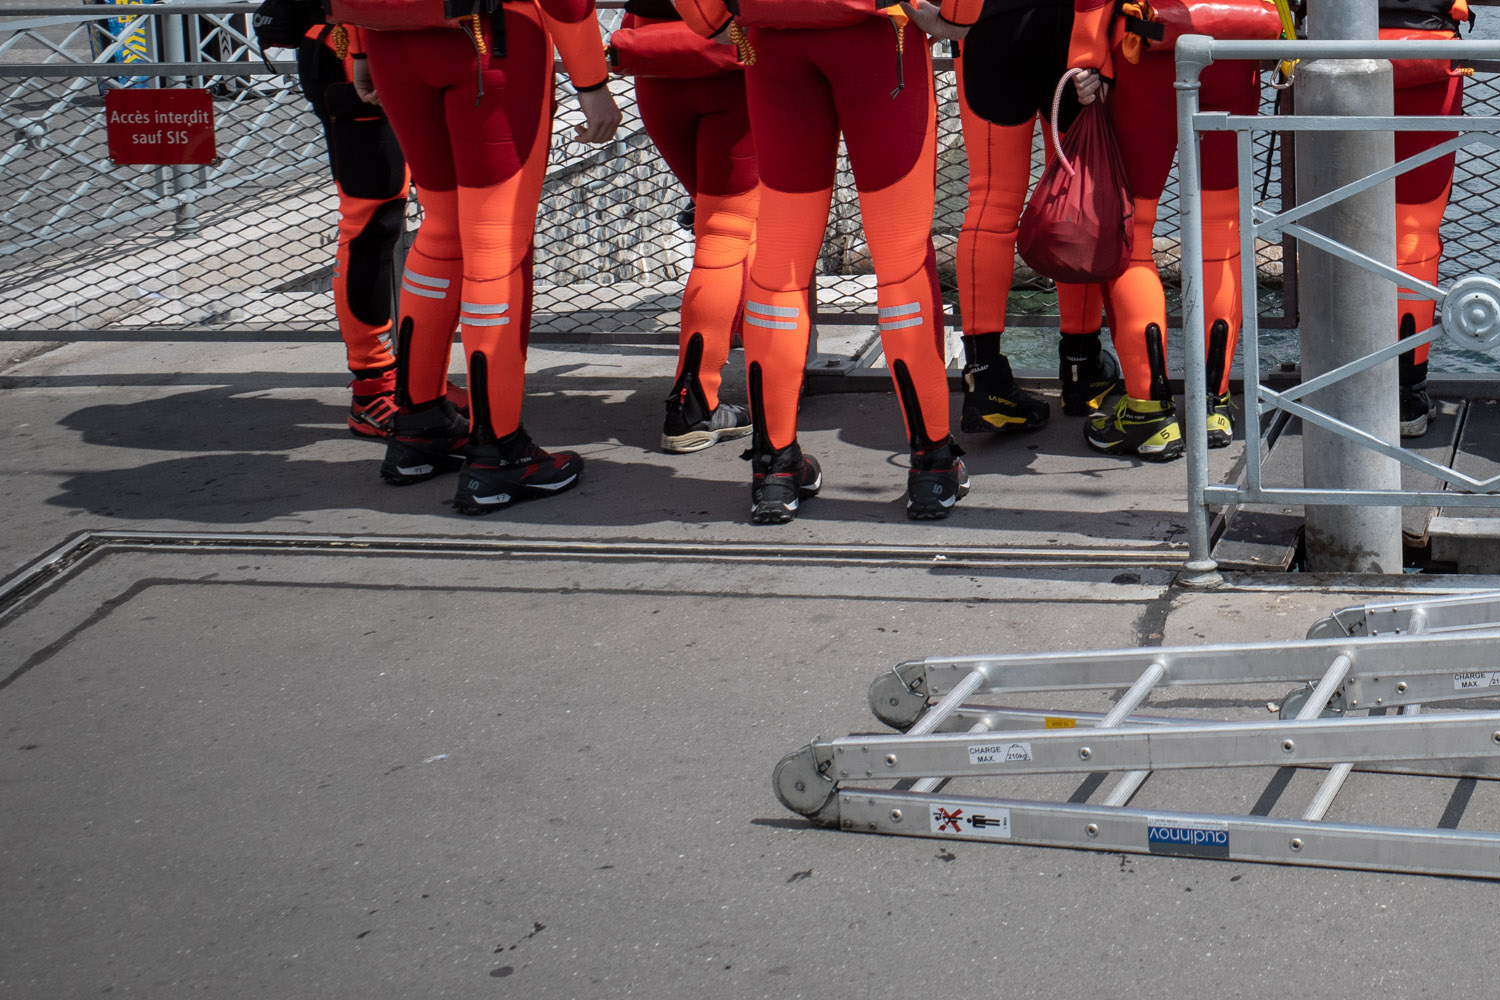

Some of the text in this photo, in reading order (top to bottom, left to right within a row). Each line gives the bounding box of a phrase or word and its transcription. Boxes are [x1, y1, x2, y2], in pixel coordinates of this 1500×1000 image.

[110, 109, 210, 125] Accès interdit
[132, 129, 190, 145] sauf SIS
[1453, 672, 1487, 681] CHARGE
[968, 746, 1002, 755] CHARGE
[977, 755, 995, 763] MAX.
[1007, 753, 1028, 761] 210kg
[1148, 827, 1227, 845] audinnov
